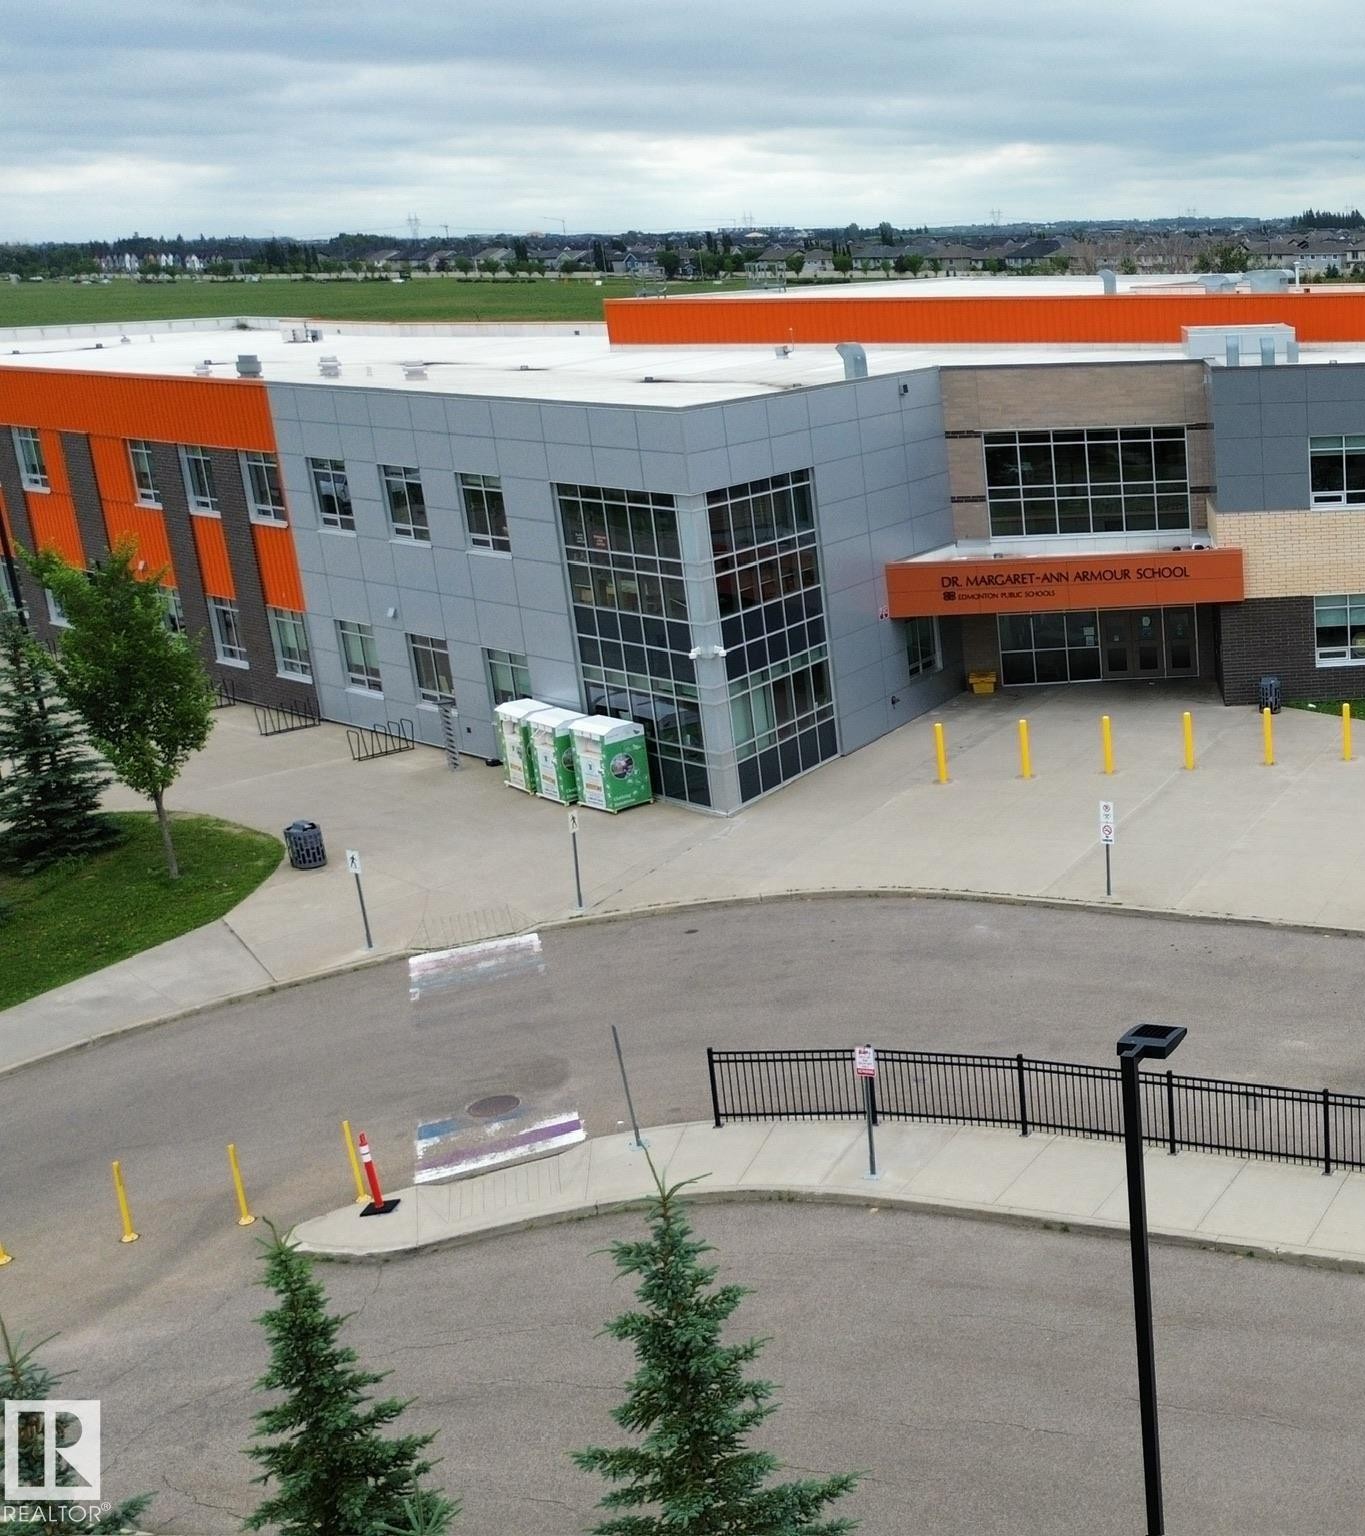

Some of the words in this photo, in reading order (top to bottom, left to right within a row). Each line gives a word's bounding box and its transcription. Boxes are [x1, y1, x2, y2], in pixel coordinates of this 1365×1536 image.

[941, 576, 963, 588] DR.
[966, 571, 1069, 587] MARGARET-ANN
[1074, 568, 1131, 582] ARMOUR
[1136, 566, 1190, 580] SCHOOL
[958, 592, 999, 601] EDMONTON
[1001, 591, 1022, 599] PUBLIC
[1025, 589, 1055, 598] SCHOOLS
